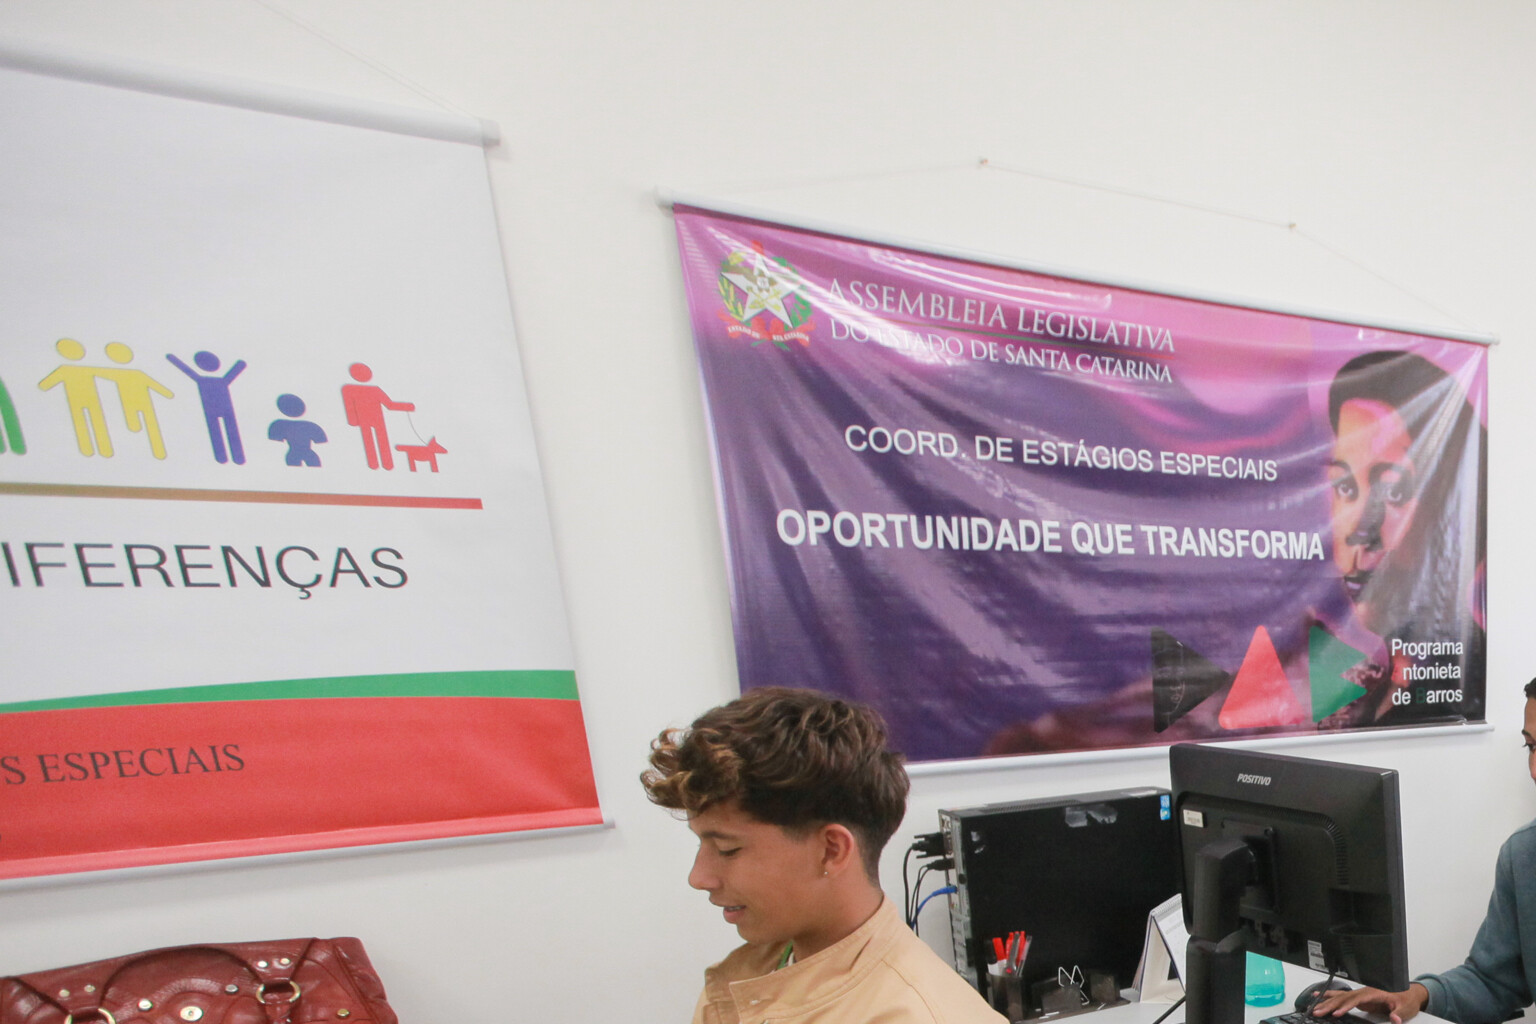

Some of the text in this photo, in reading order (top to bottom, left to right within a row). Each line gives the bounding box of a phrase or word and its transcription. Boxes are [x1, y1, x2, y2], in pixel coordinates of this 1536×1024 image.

[829, 278, 1175, 352] ASSEMBLEIA LEGISLATIVA
[830, 318, 869, 343] DO
[970, 339, 999, 362] DE
[1005, 344, 1071, 371] SANTA
[1075, 354, 1173, 384] CATARINA
[845, 425, 1278, 481] COORD. DE ESTÁGIOS ESPECIAIS
[776, 508, 1325, 560] OPORTUNIDADE QUE TRANSFORMA
[0, 542, 408, 600] IFERENÇAS
[1391, 637, 1464, 660] Programa
[1399, 660, 1462, 680] ntonieta
[1391, 686, 1411, 705] de
[0, 744, 245, 785] S ESPECIAIS
[1237, 772, 1271, 786] POSITIVO
